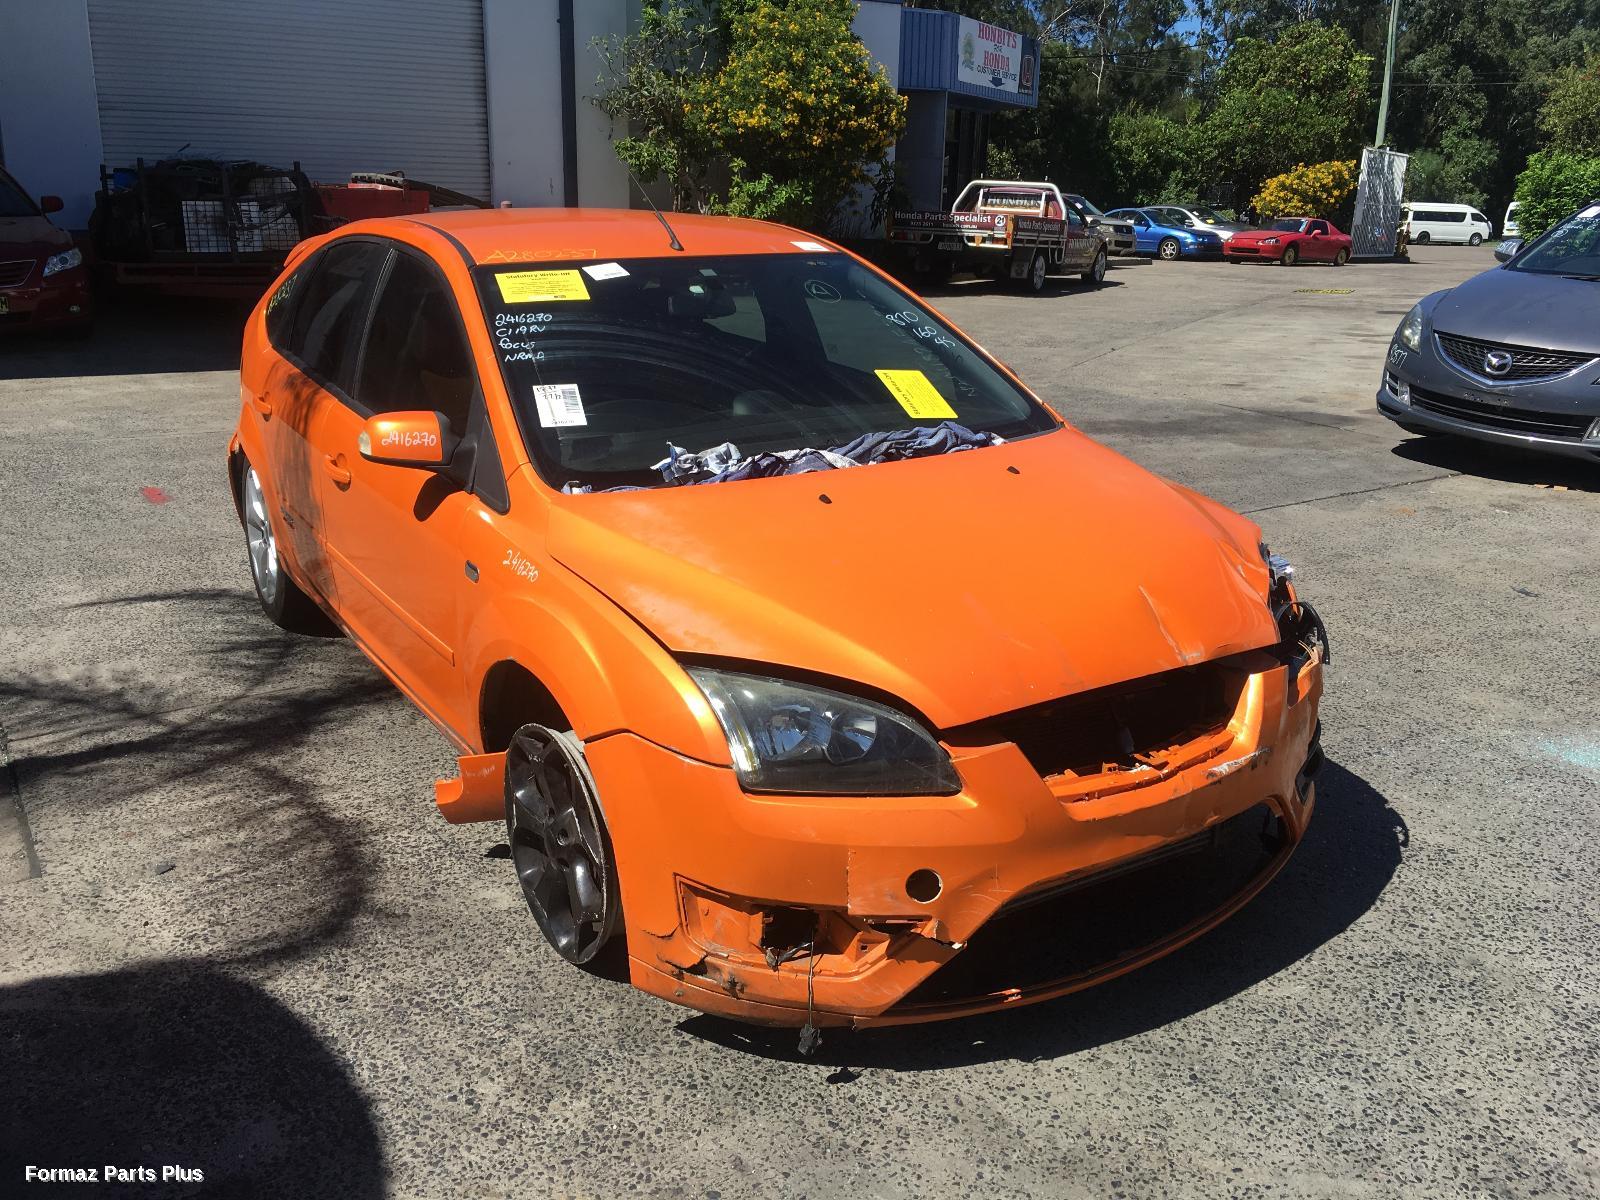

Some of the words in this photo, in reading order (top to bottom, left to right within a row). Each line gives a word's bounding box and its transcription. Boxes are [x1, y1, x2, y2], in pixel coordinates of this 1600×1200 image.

[984, 50, 1010, 72] HONDA
[976, 64, 1000, 78] CUSTOMER
[1001, 70, 1017, 82] SERVICE
[894, 211, 922, 220] Honda
[924, 212, 947, 221] Parts
[949, 213, 991, 224] Specialist
[495, 312, 553, 327] 2416270
[381, 430, 437, 447] 2416270
[502, 549, 539, 583] 2416270
